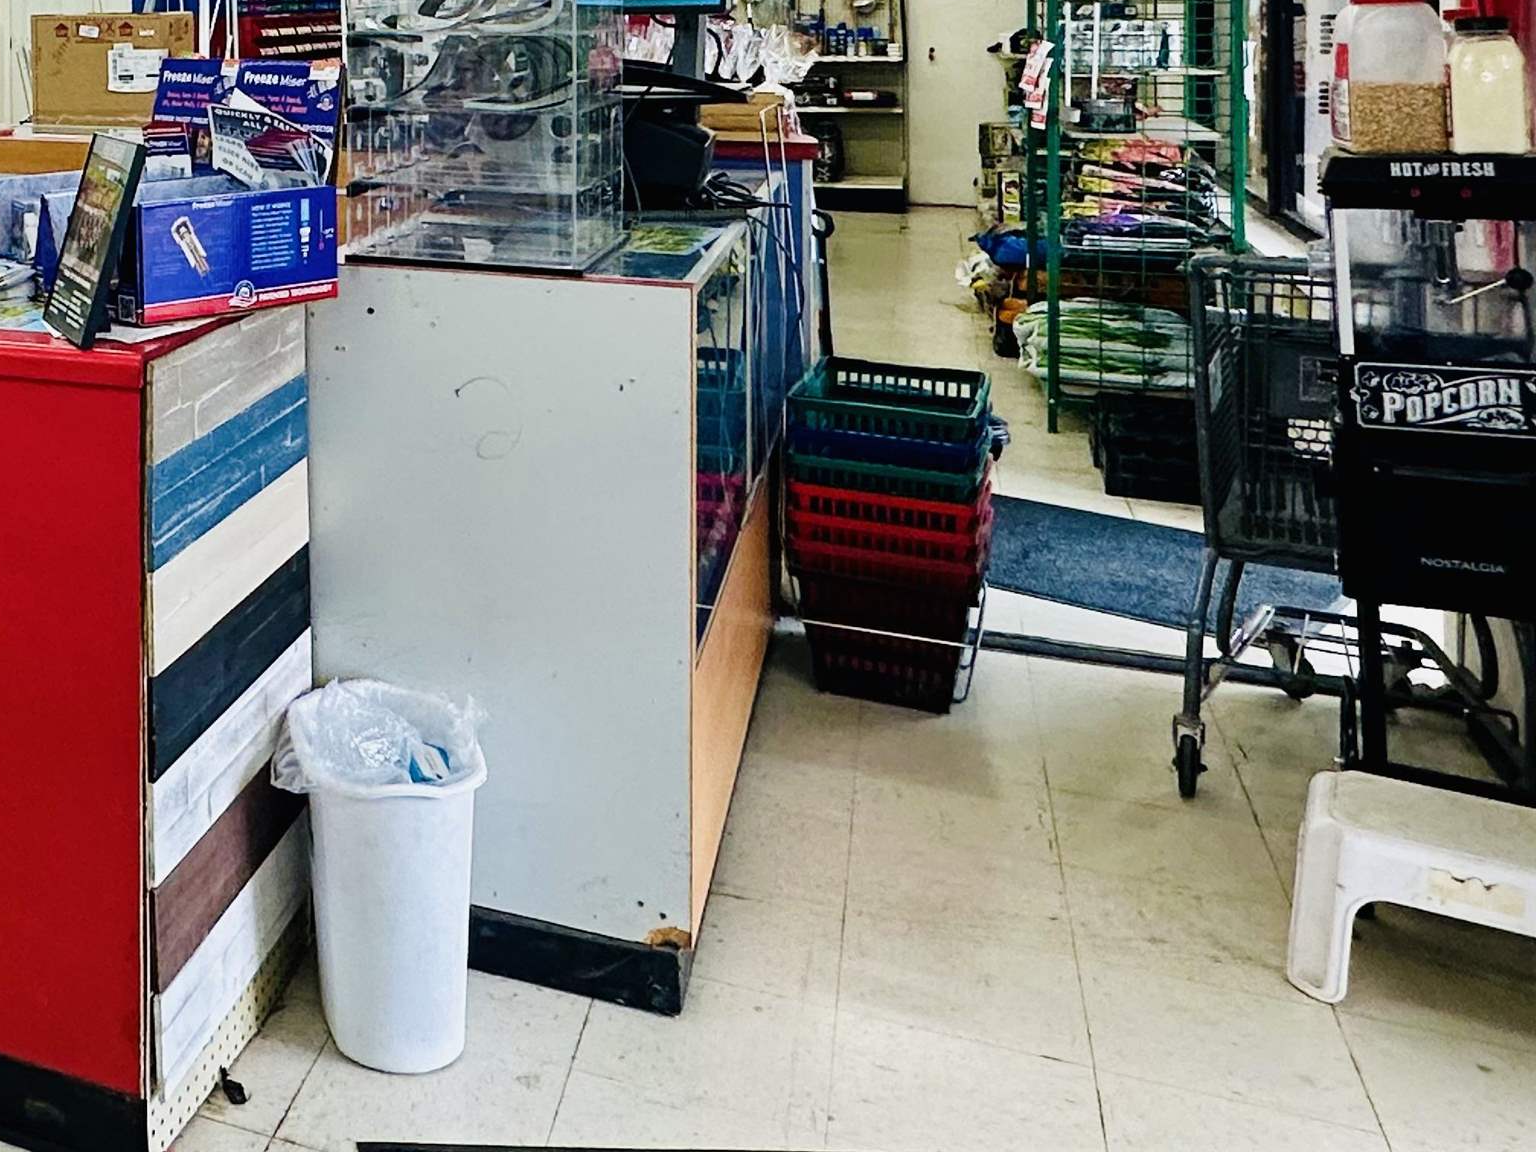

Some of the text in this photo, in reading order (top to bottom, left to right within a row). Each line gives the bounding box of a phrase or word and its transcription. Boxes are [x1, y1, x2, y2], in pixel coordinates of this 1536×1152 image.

[163, 70, 192, 84] Freeze
[244, 71, 279, 86] Freeze
[214, 108, 261, 120] QUICKLY
[1390, 162, 1422, 176] HOT
[1442, 162, 1495, 177] FRESH
[1382, 378, 1522, 423] POPCORN
[1421, 557, 1505, 573] NOSTALGIA
